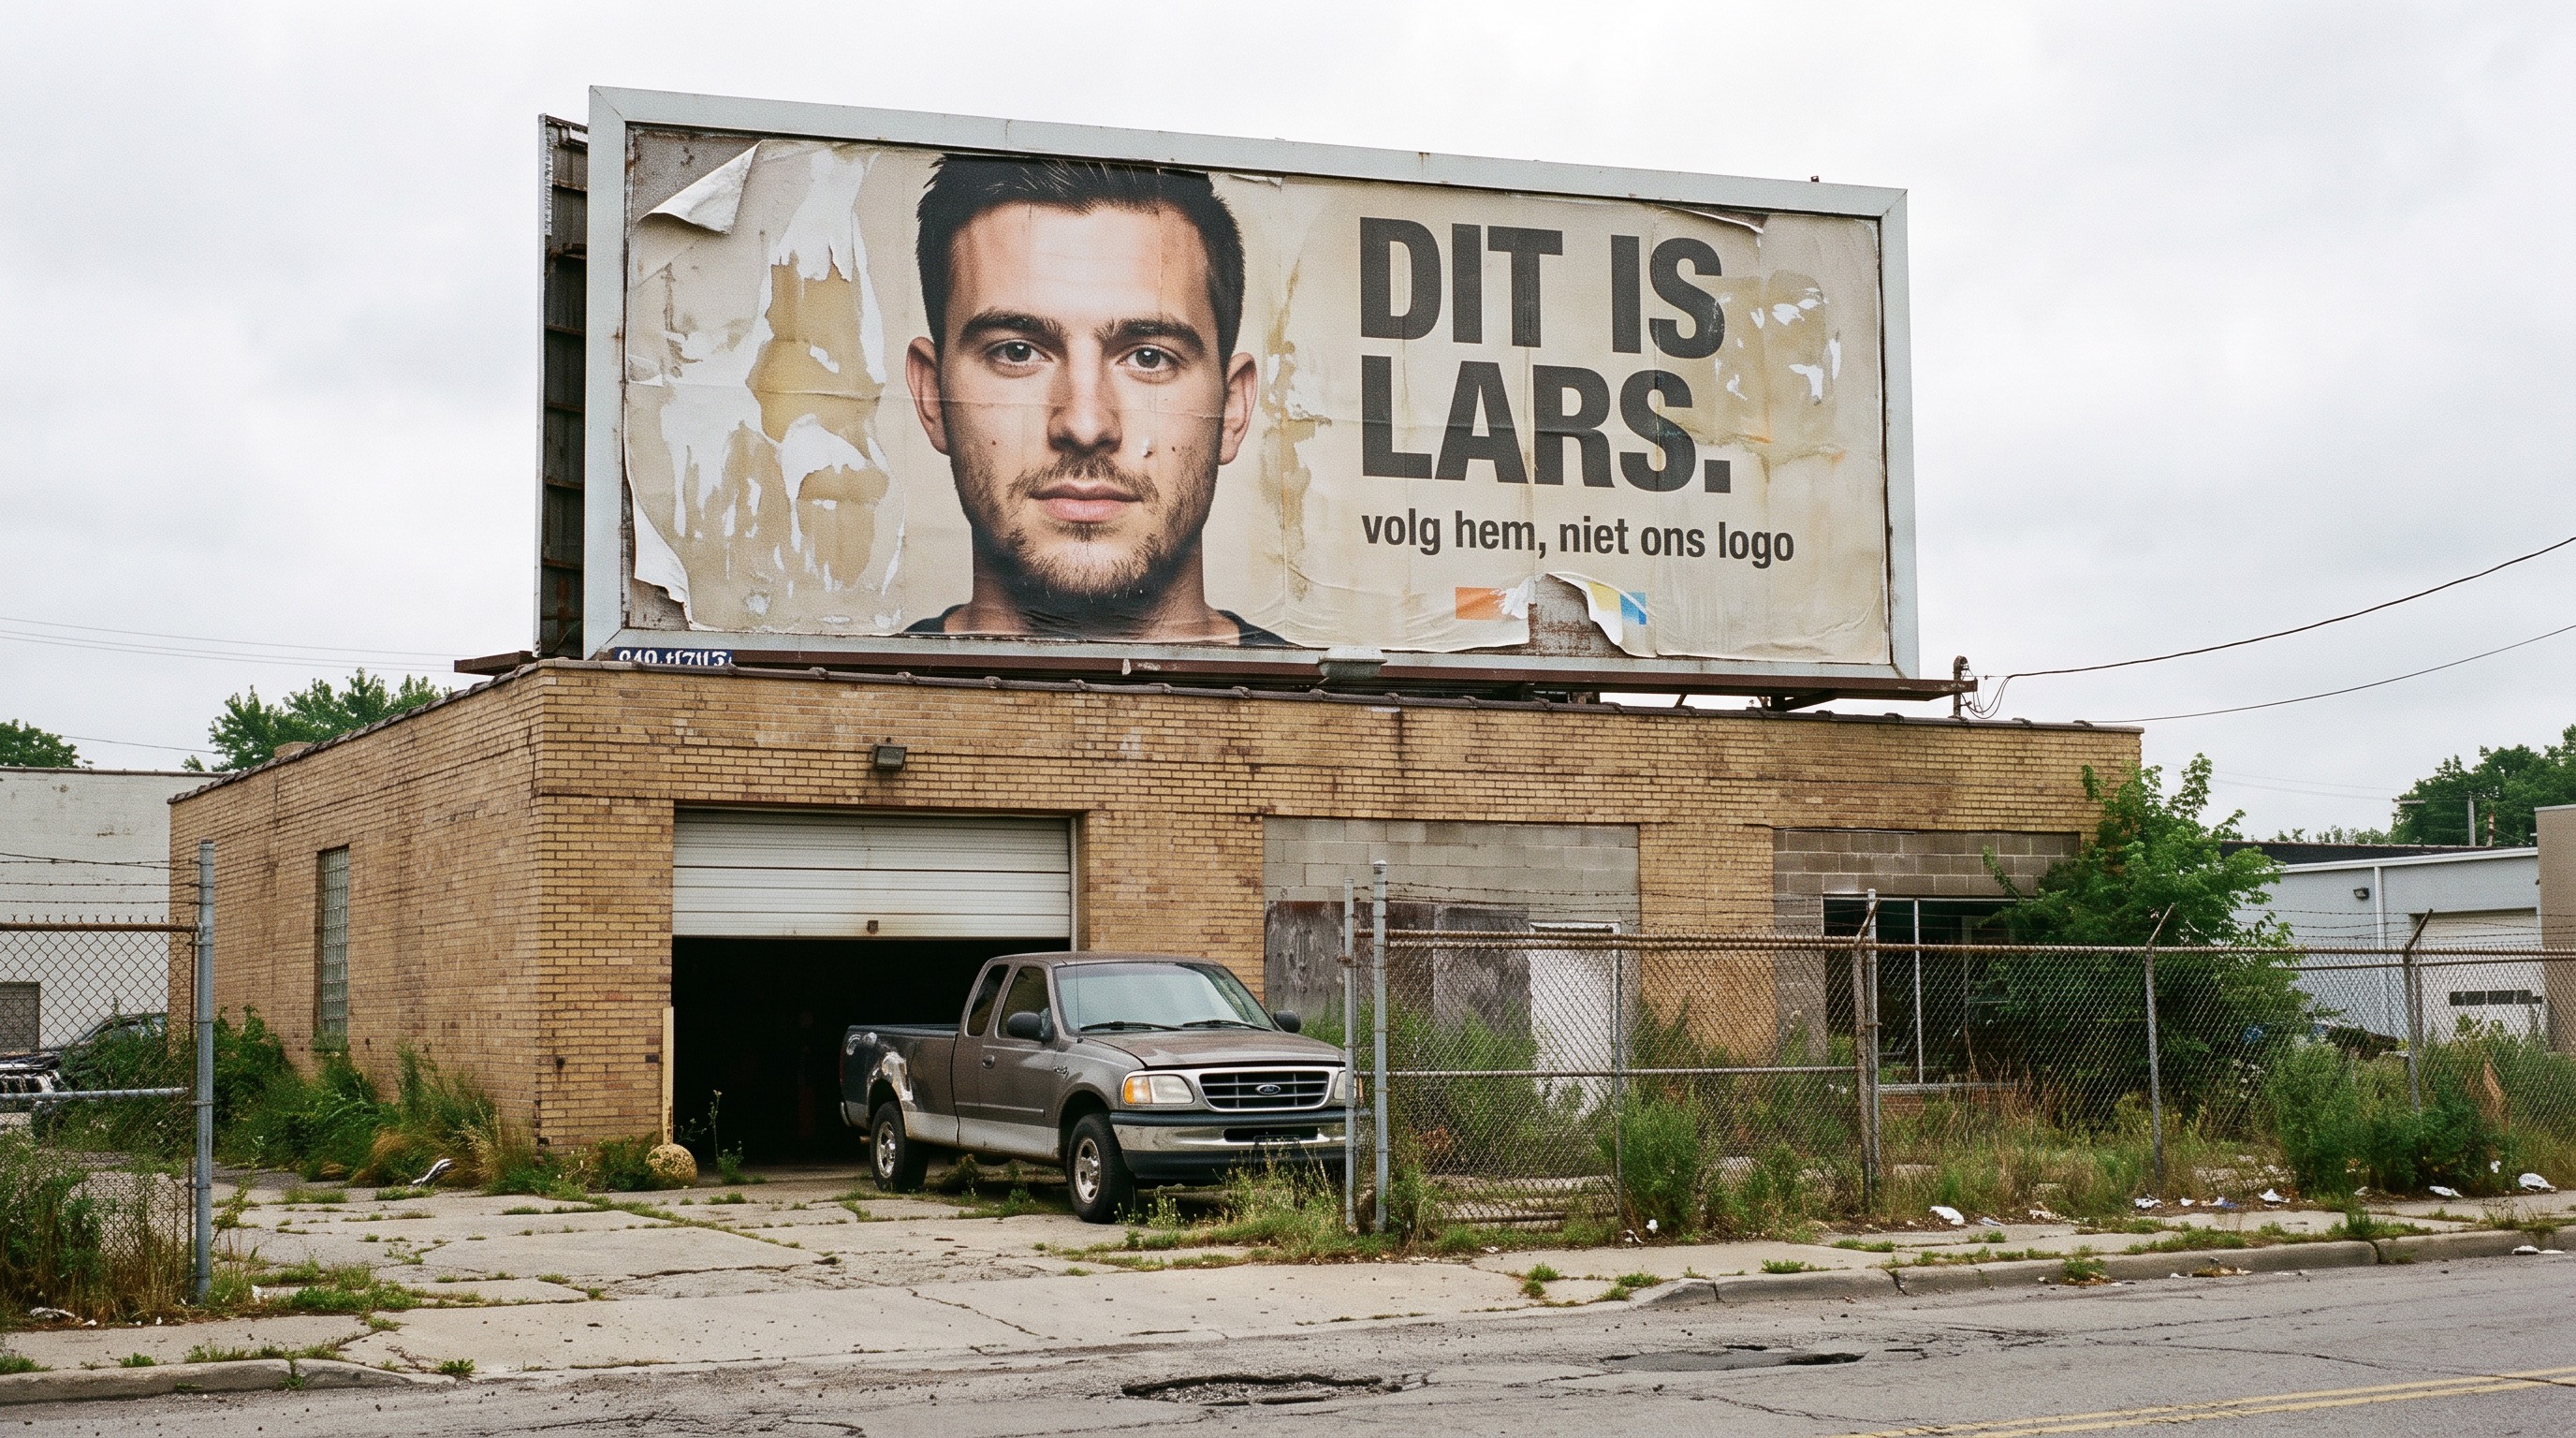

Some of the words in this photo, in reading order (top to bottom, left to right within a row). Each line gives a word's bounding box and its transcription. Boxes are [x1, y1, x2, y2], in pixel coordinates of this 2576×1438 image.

[1360, 216, 1563, 348] DIT
[1611, 234, 1725, 360] IS
[1361, 355, 1732, 493] LARS.
[1361, 508, 1442, 556] volg
[1456, 510, 1546, 560] hem,
[1559, 515, 1629, 555] niet
[1641, 526, 1706, 559] ons
[1719, 521, 1795, 569] logo
